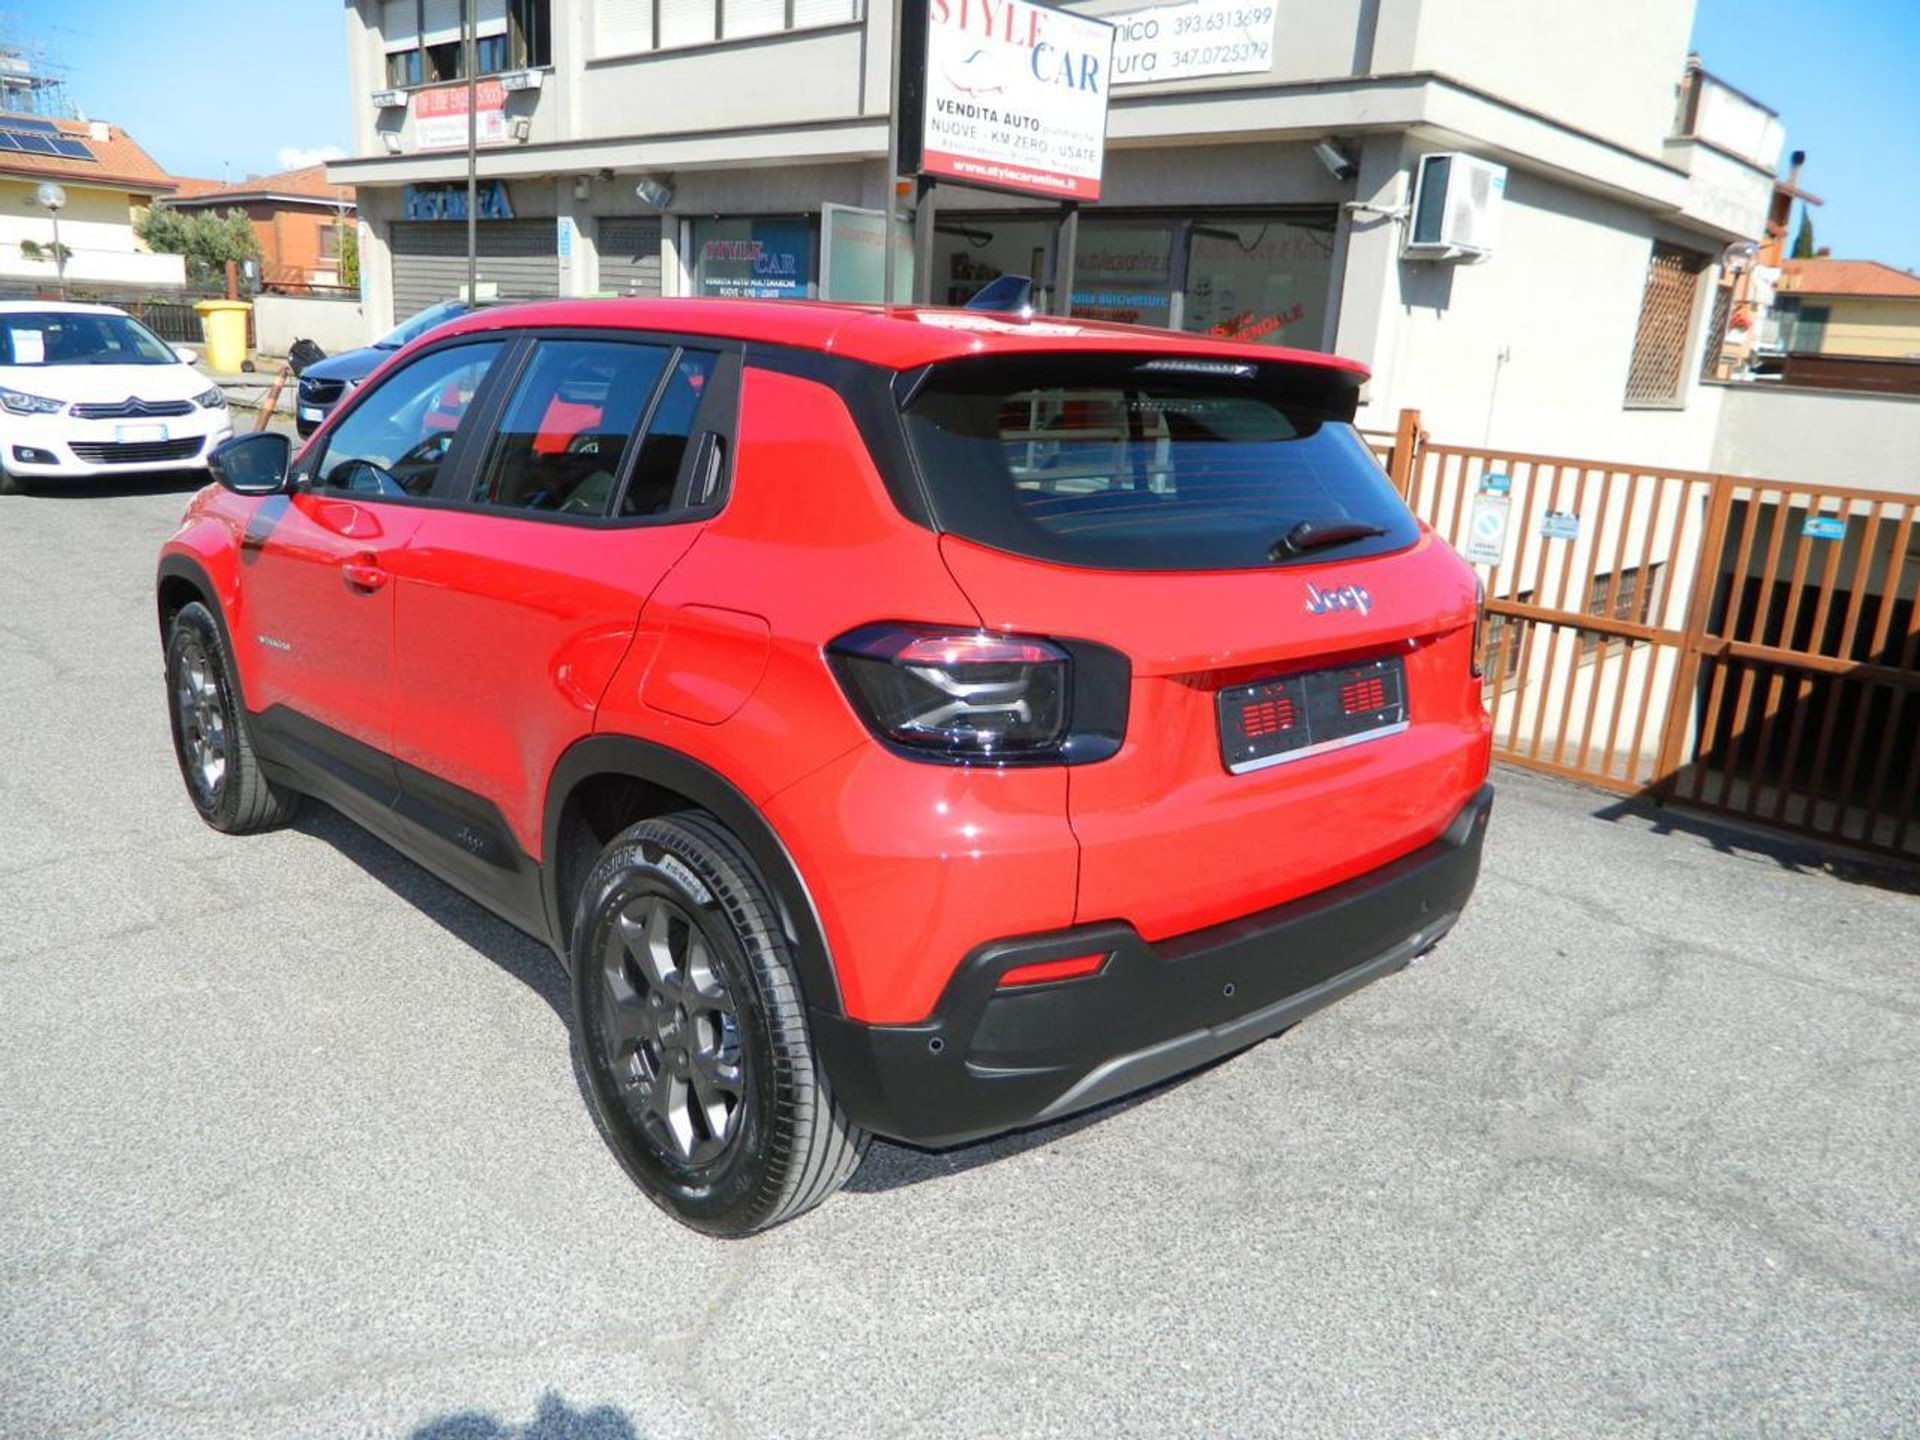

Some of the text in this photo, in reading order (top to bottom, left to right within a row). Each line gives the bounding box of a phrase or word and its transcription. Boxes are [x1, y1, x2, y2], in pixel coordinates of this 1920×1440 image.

[930, 0, 1047, 48] STYLE
[1173, 8, 1273, 35] 393.6313699
[1031, 42, 1099, 94] CAR
[1171, 43, 1270, 67] 347.0725379
[936, 98, 998, 123] VENDITA
[1003, 114, 1040, 132] AUTO
[931, 118, 977, 140] NUOVE
[991, 131, 1009, 145] KM
[1014, 135, 1047, 152] ZERO
[1060, 145, 1097, 162] USATE
[1305, 583, 1373, 617] Jeep
